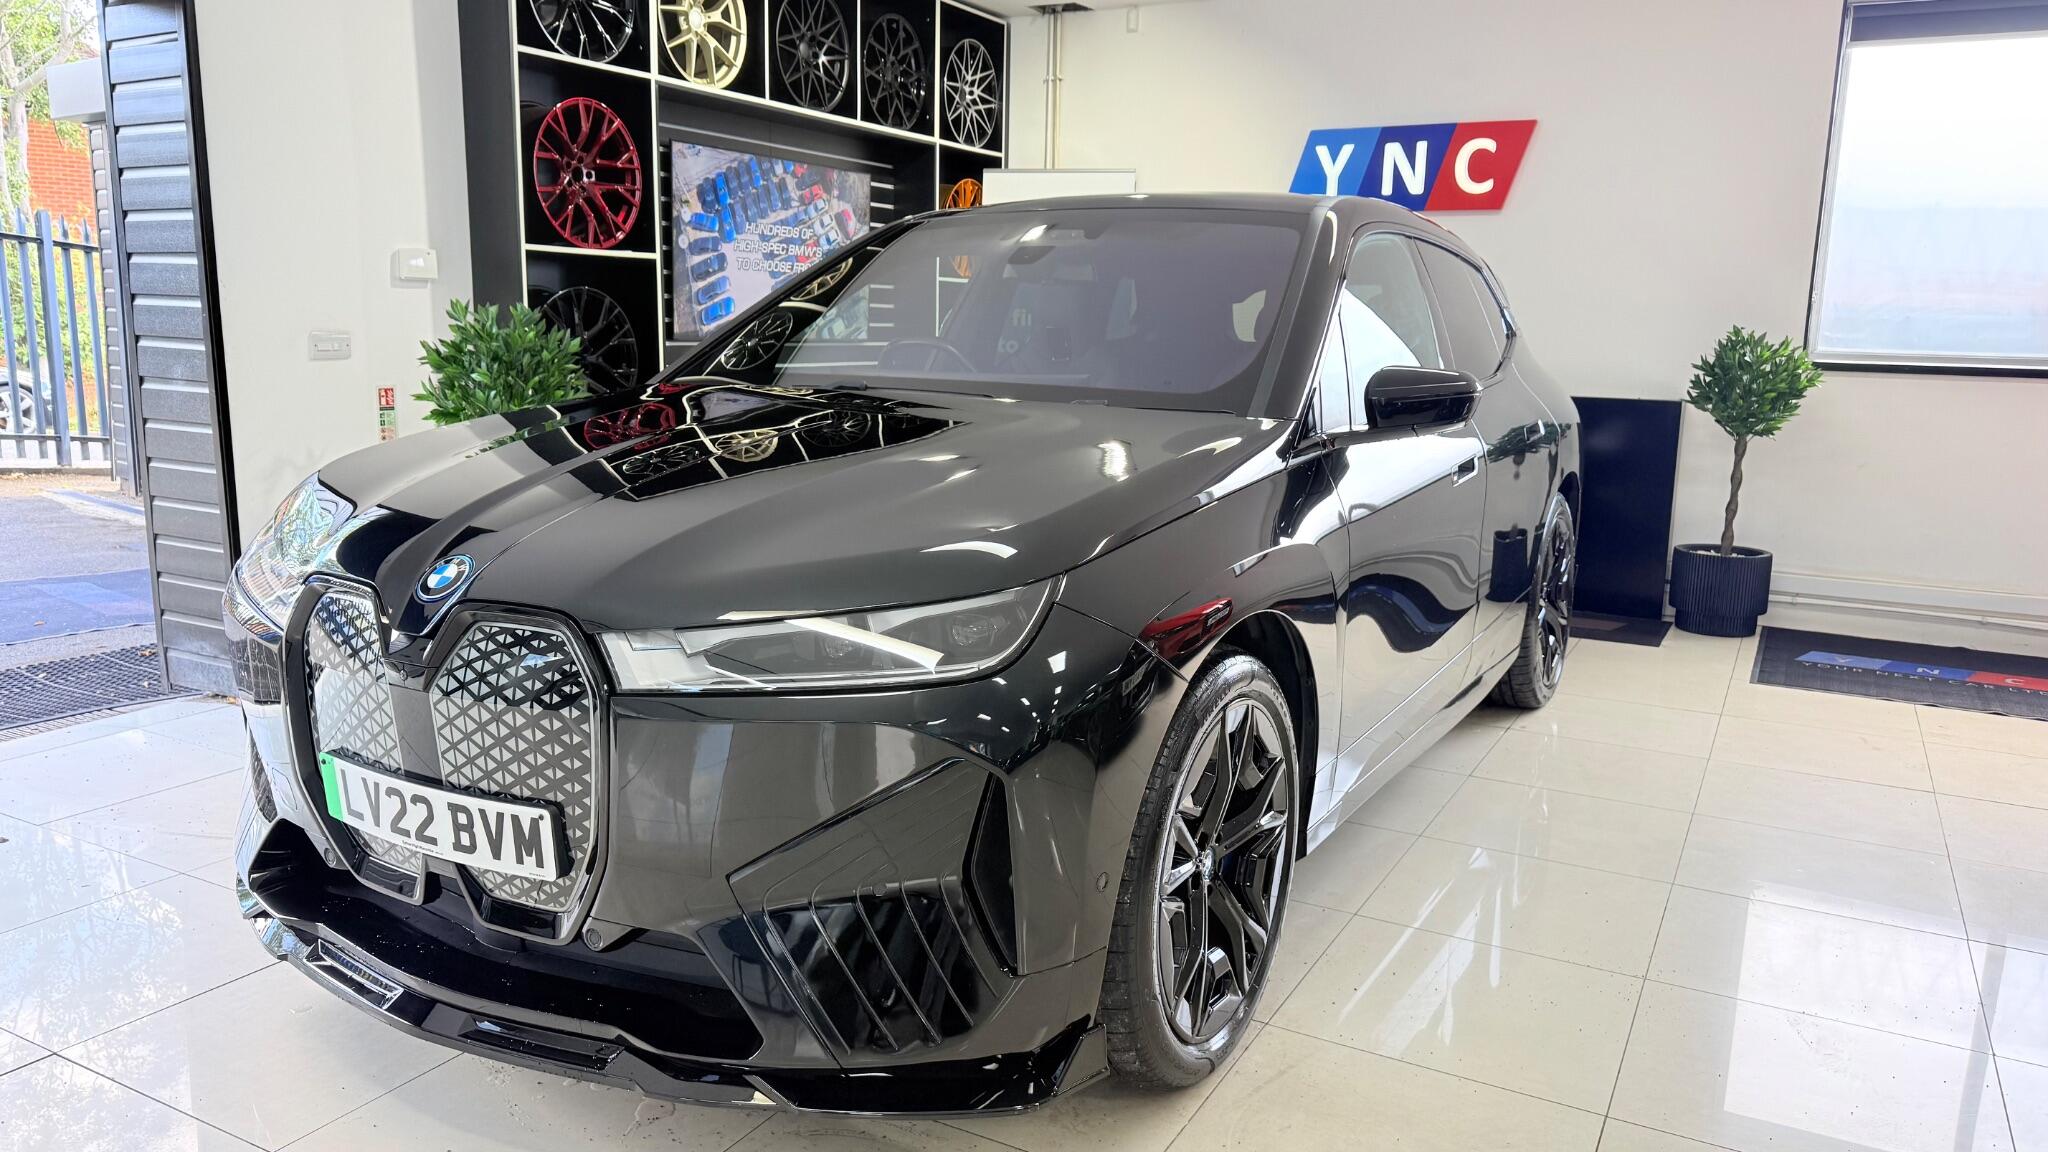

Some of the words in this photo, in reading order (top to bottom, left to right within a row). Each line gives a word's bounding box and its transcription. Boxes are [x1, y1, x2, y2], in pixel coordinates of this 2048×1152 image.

[1315, 137, 1497, 196] YNC
[745, 222, 799, 238] HUNDREDS
[801, 228, 814, 239] OF
[734, 239, 787, 255] HIGH-SPEC
[788, 244, 822, 257] BMW'S
[737, 257, 750, 270] TO
[752, 260, 792, 273] CHOOSE
[341, 768, 438, 846] LV22
[447, 802, 544, 868] BVM
